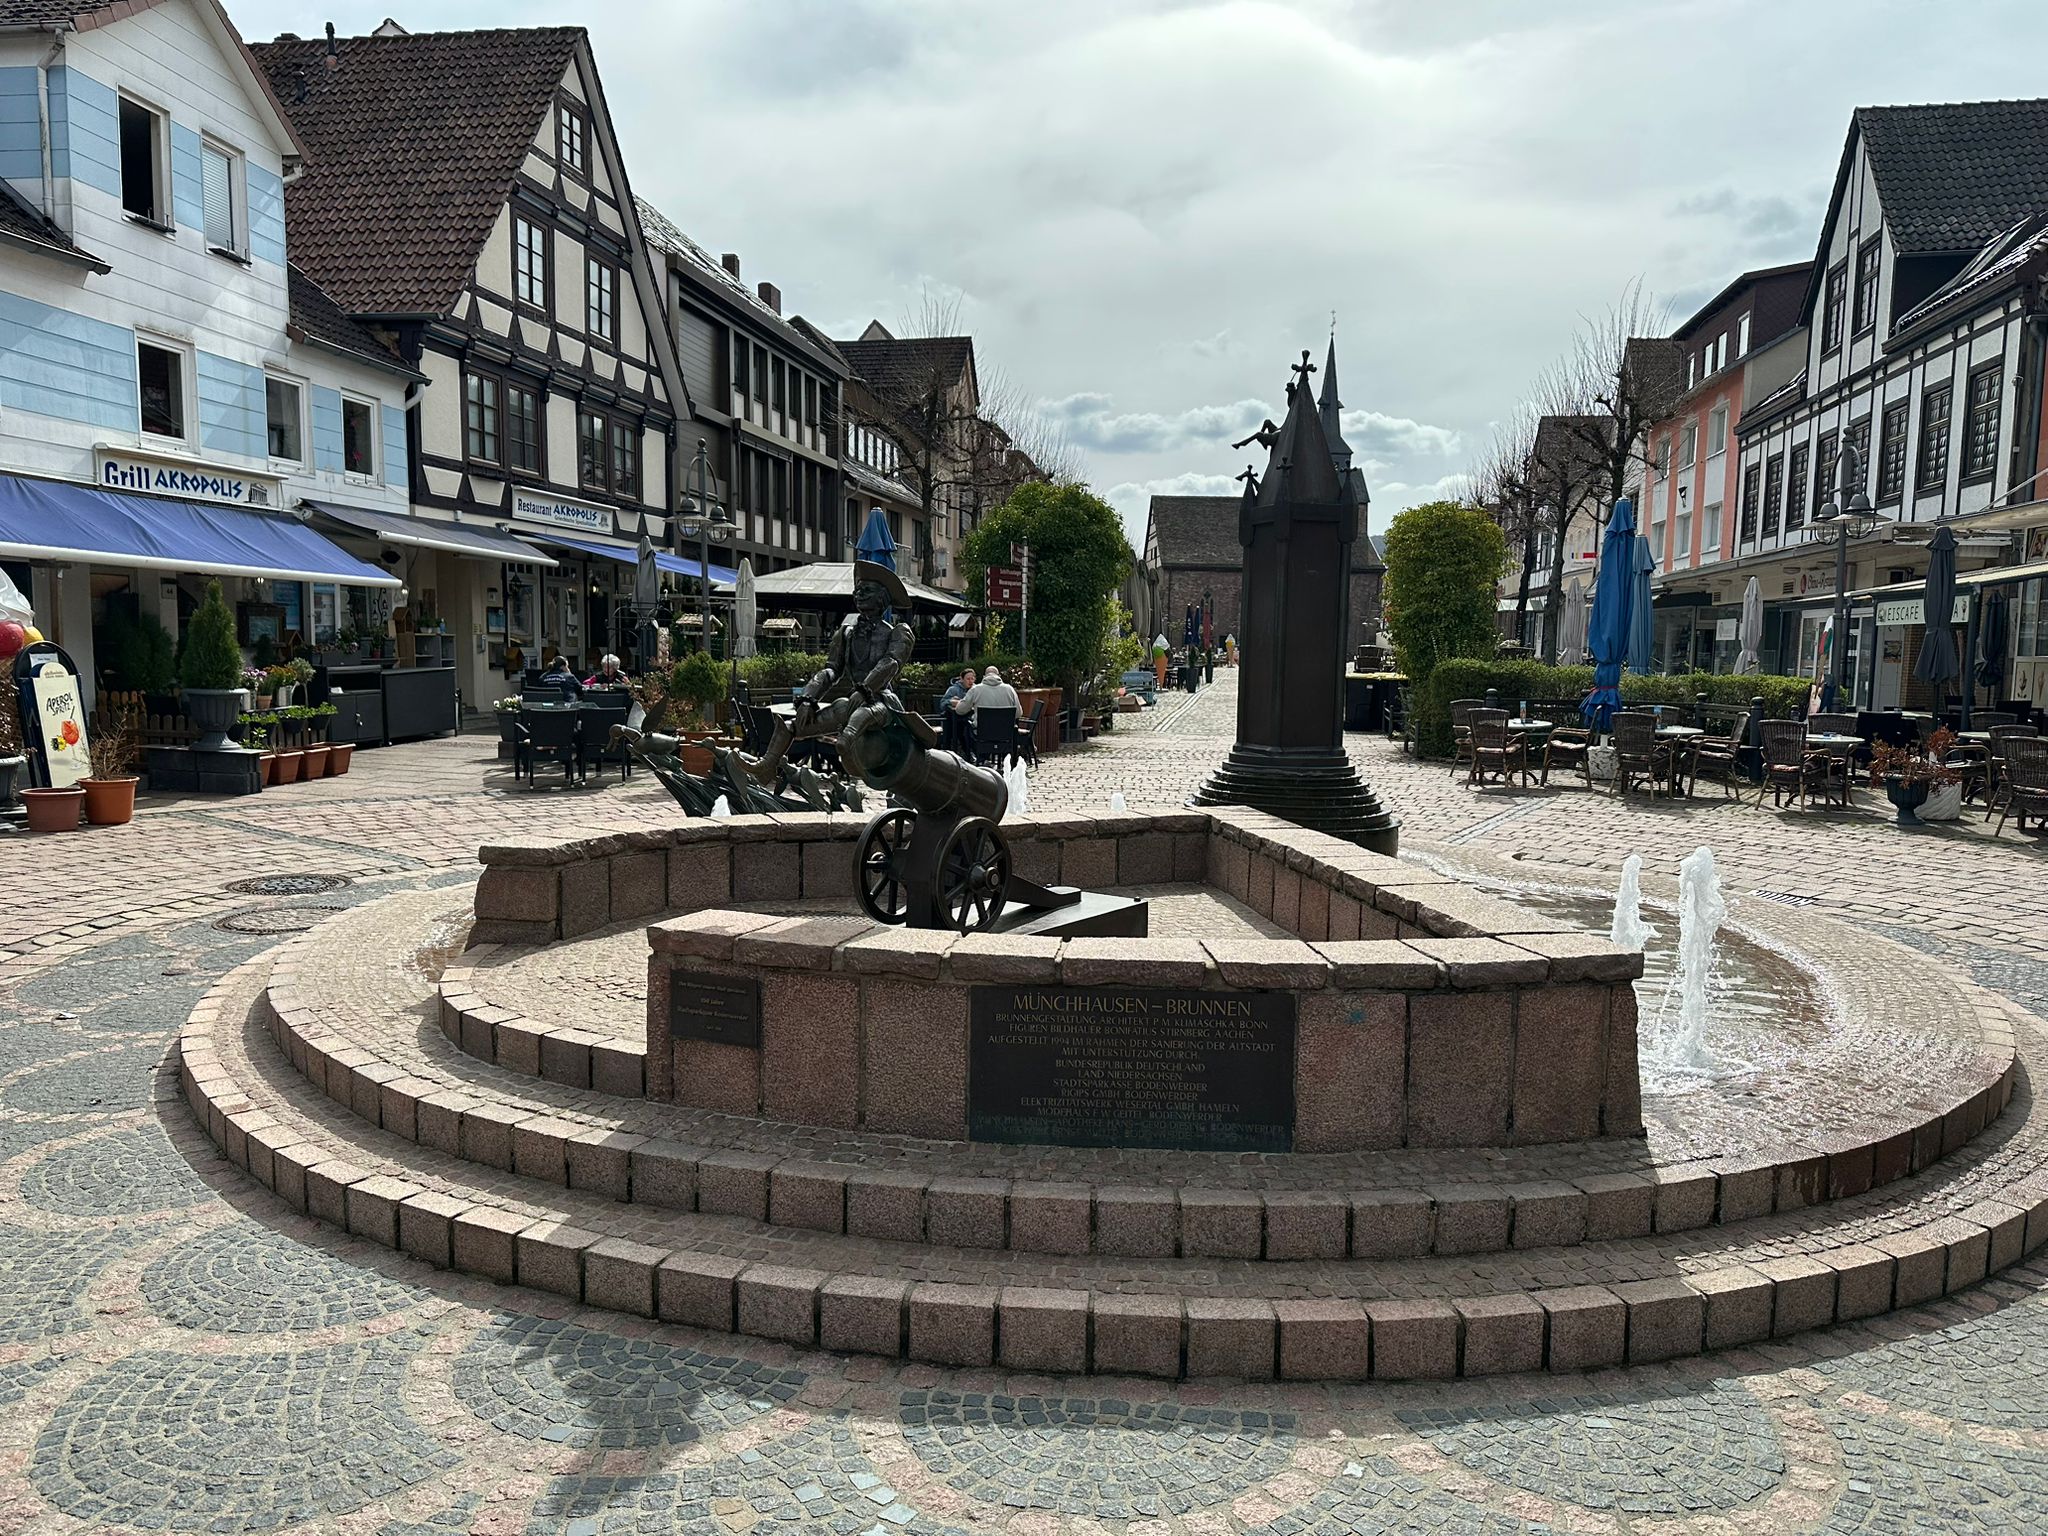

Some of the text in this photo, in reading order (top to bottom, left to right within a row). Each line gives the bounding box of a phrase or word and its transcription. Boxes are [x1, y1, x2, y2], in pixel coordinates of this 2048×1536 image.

[105, 460, 242, 499] Grill AKROPOLIS
[517, 498, 598, 521] Restaurant AKROPOLIS
[46, 692, 73, 712] APEROL
[1013, 992, 1148, 1014] MÜNCHHAUSEN
[1166, 998, 1251, 1017] BRUNNEN
[995, 1013, 1096, 1025] BRUNNENGESTALTUNG
[1100, 1016, 1150, 1026] ARCHITEKT
[1009, 1023, 1048, 1033] FIGUREN
[1050, 1024, 1102, 1034] BILDHAUER
[1215, 1029, 1254, 1039] AACHEN
[1063, 1047, 1079, 1056] MIT
[1085, 1038, 1127, 1047] RAHMEN
[1130, 1039, 1148, 1048] DER
[1151, 1039, 1204, 1050] SANIERUNG
[1206, 1041, 1225, 1051] DER
[1229, 1042, 1276, 1052] ALTSTADT
[1055, 1059, 1206, 1072] BUNDESREPUBLIK DEUTSCHLAND
[1078, 1069, 1183, 1080] LAND NIEDERSACHSEN
[1052, 1079, 1208, 1091] STADTSPARKASSE BODENWERDER
[1124, 1090, 1199, 1101] BODENWERDER
